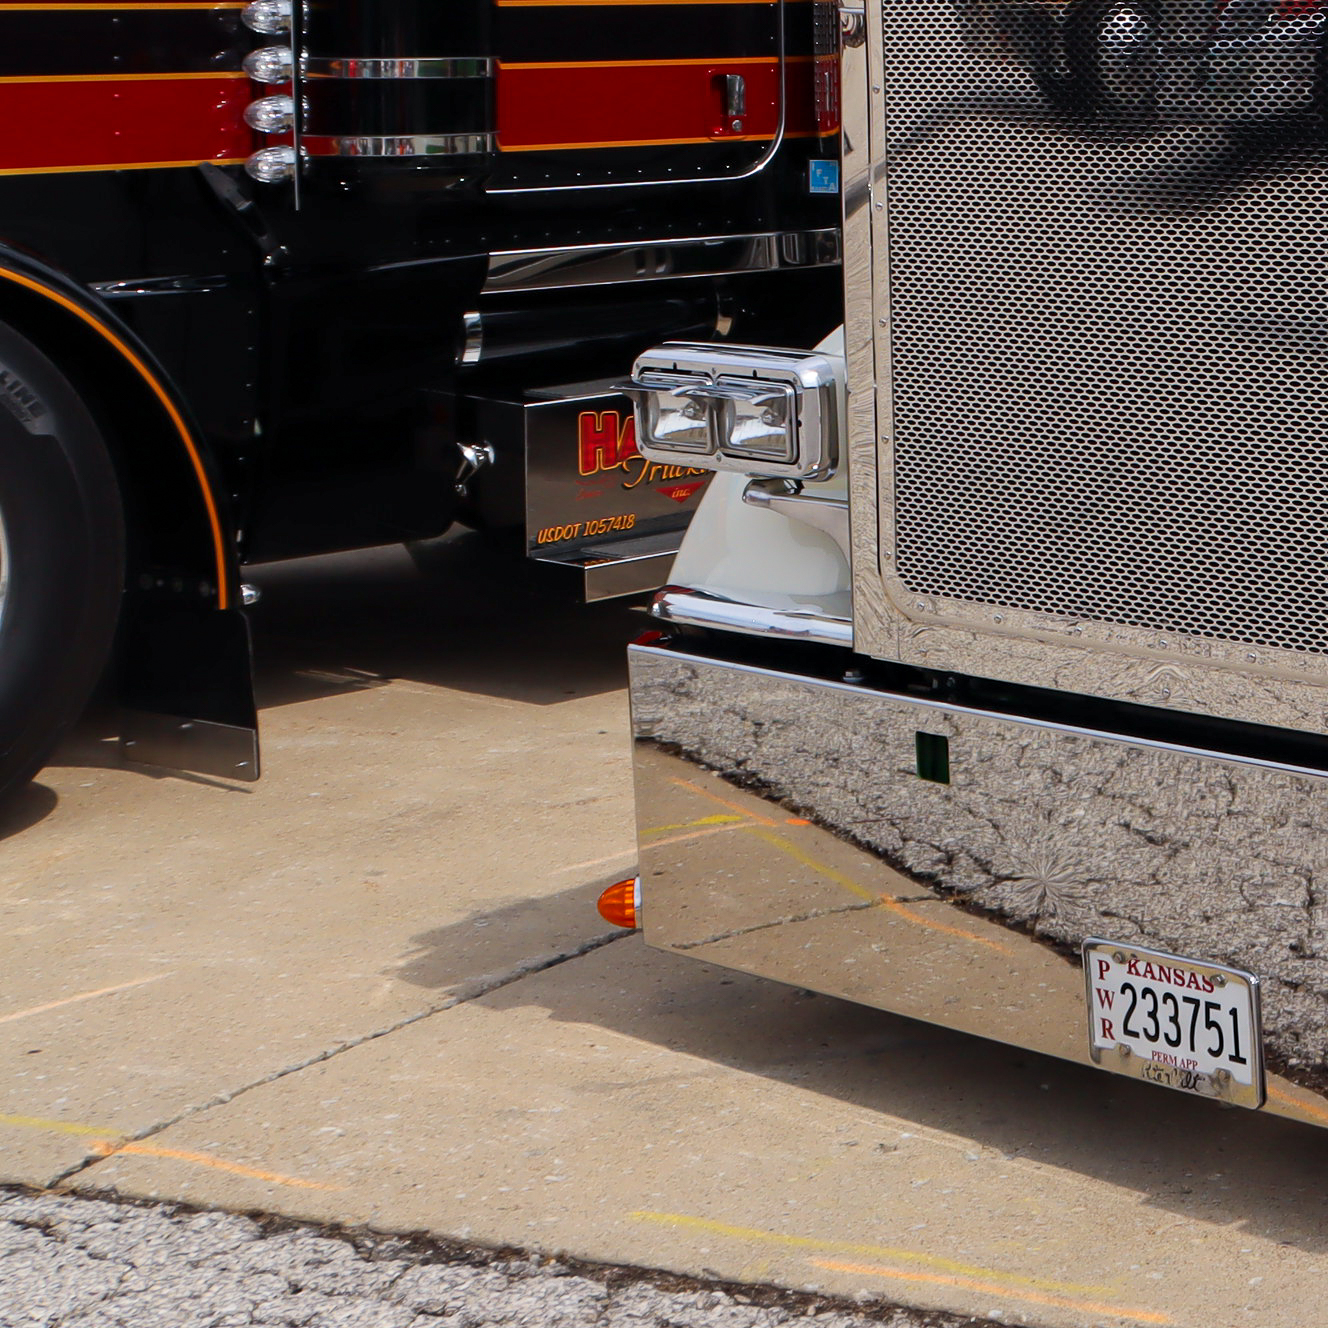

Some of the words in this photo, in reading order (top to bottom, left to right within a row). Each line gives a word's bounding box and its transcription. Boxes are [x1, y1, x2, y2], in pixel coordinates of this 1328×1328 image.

[672, 487, 691, 498] inc.
[538, 523, 582, 544] USDOT
[583, 513, 636, 537] 1057418
[1126, 958, 1215, 994] KANSAS
[1119, 981, 1248, 1066] 233751
[1151, 1050, 1178, 1067] PERM
[1180, 1057, 1198, 1071] APP
